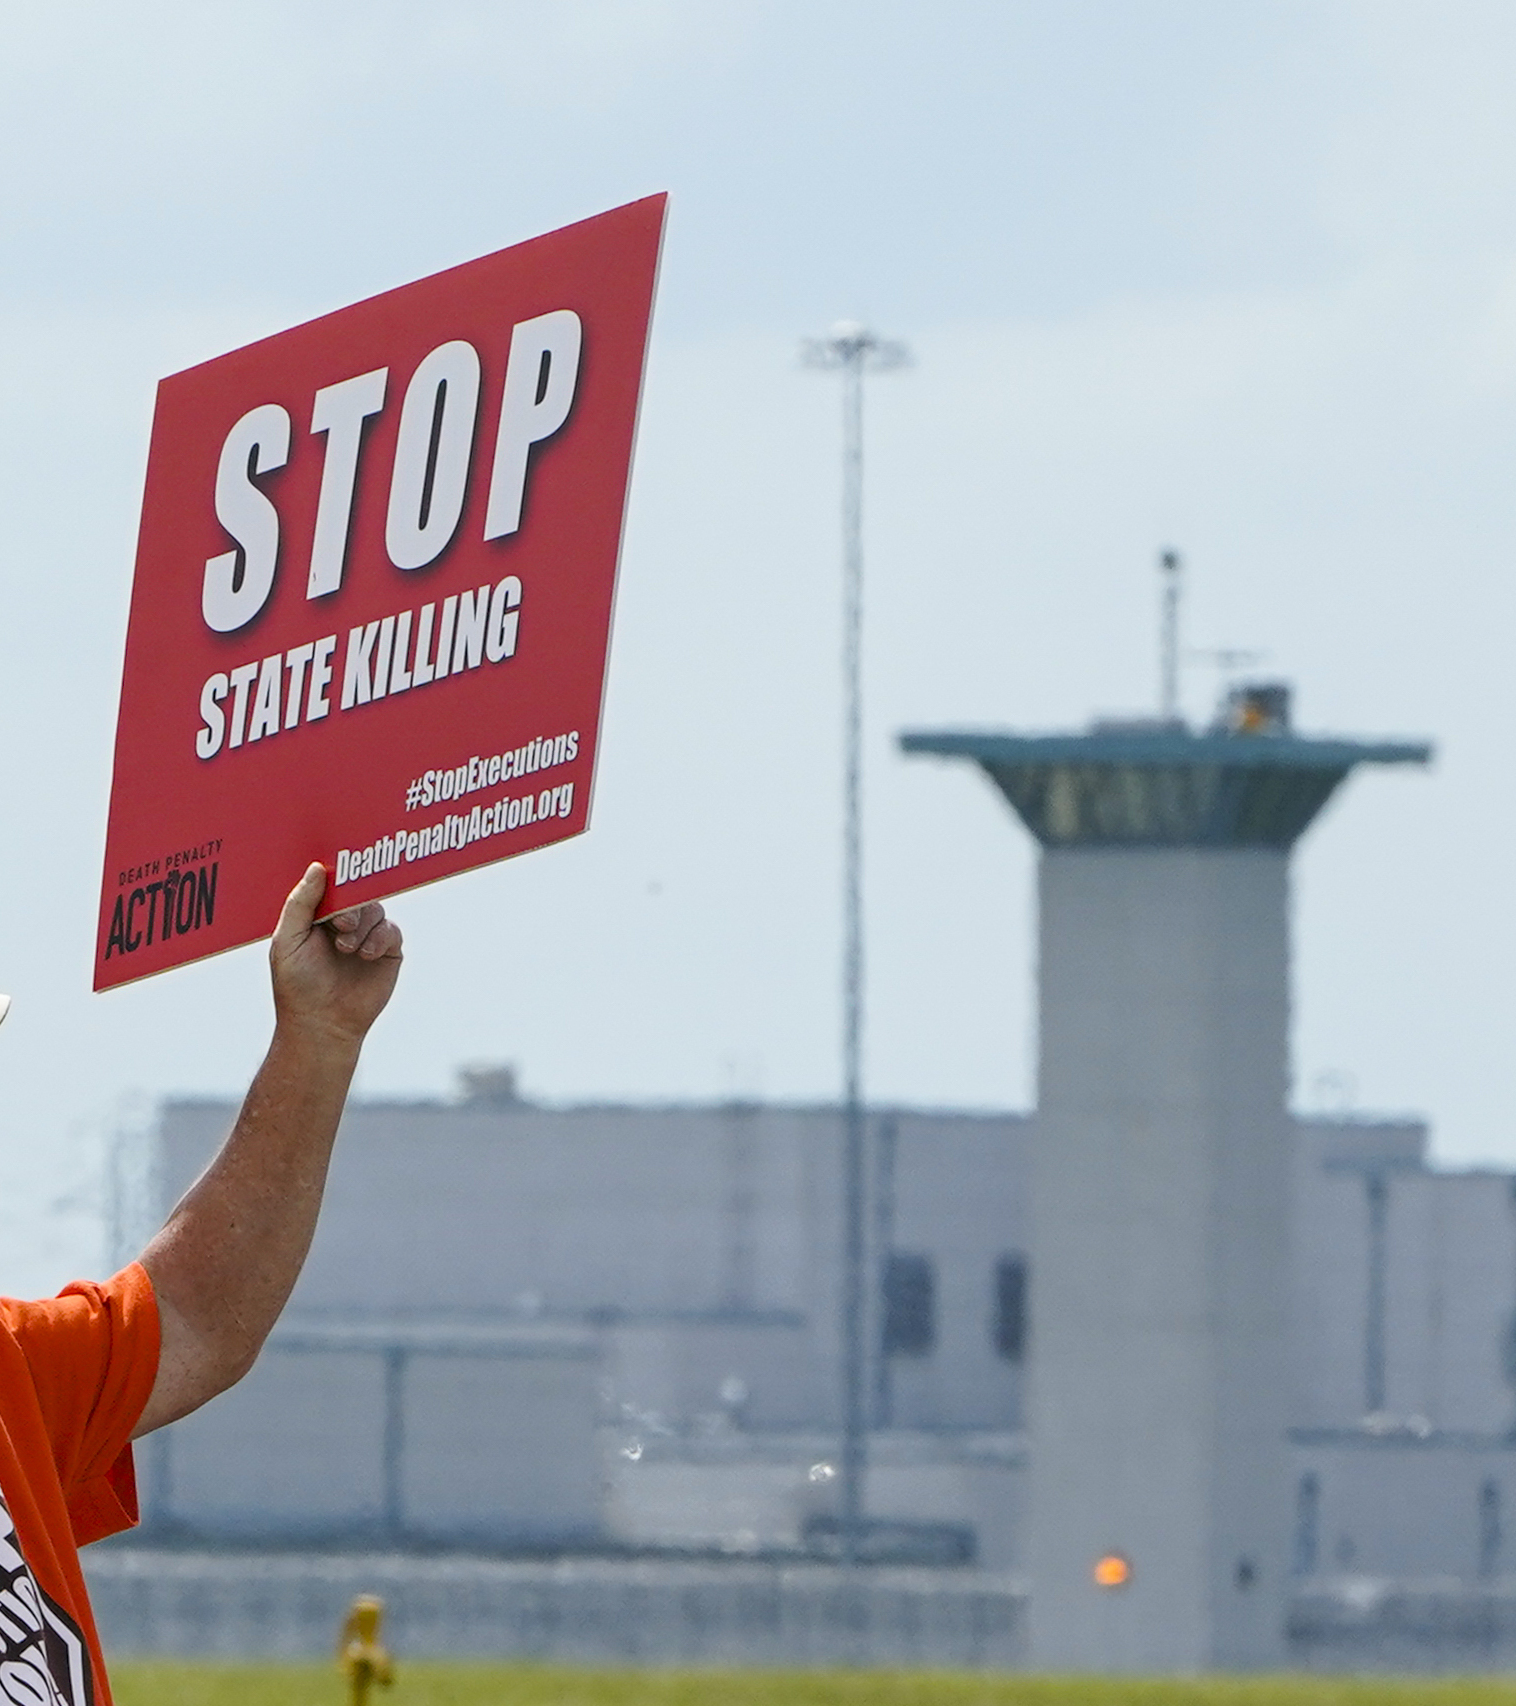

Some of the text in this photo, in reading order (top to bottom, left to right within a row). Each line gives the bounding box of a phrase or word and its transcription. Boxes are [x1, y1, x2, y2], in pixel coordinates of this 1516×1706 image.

[201, 308, 584, 634] STOP
[195, 575, 523, 761] STATE KILLING
[405, 730, 579, 812] #StopExecutions
[118, 838, 224, 887] DEATH PENALTY
[334, 782, 574, 887] DeathPenaltyAction.org
[104, 862, 220, 961] ACTION
